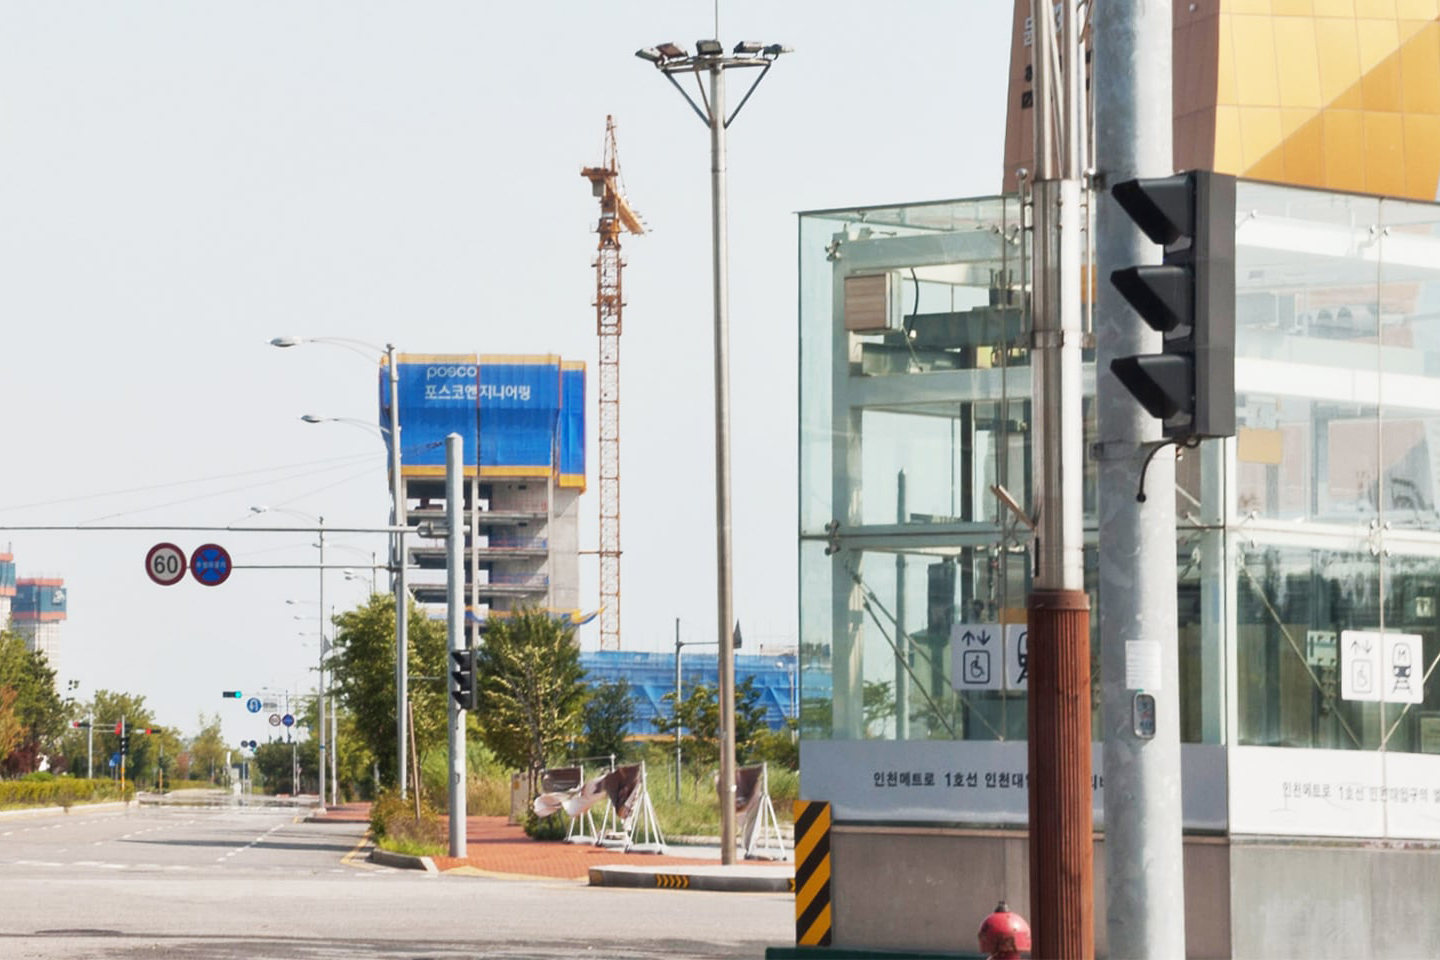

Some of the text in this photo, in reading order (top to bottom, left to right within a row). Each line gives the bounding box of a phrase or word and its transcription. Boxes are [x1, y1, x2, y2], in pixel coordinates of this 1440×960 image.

[427, 367, 477, 381] posco
[425, 385, 531, 401] 포스코엔지니어링
[154, 555, 178, 574] 60
[944, 771, 978, 788] 1호선
